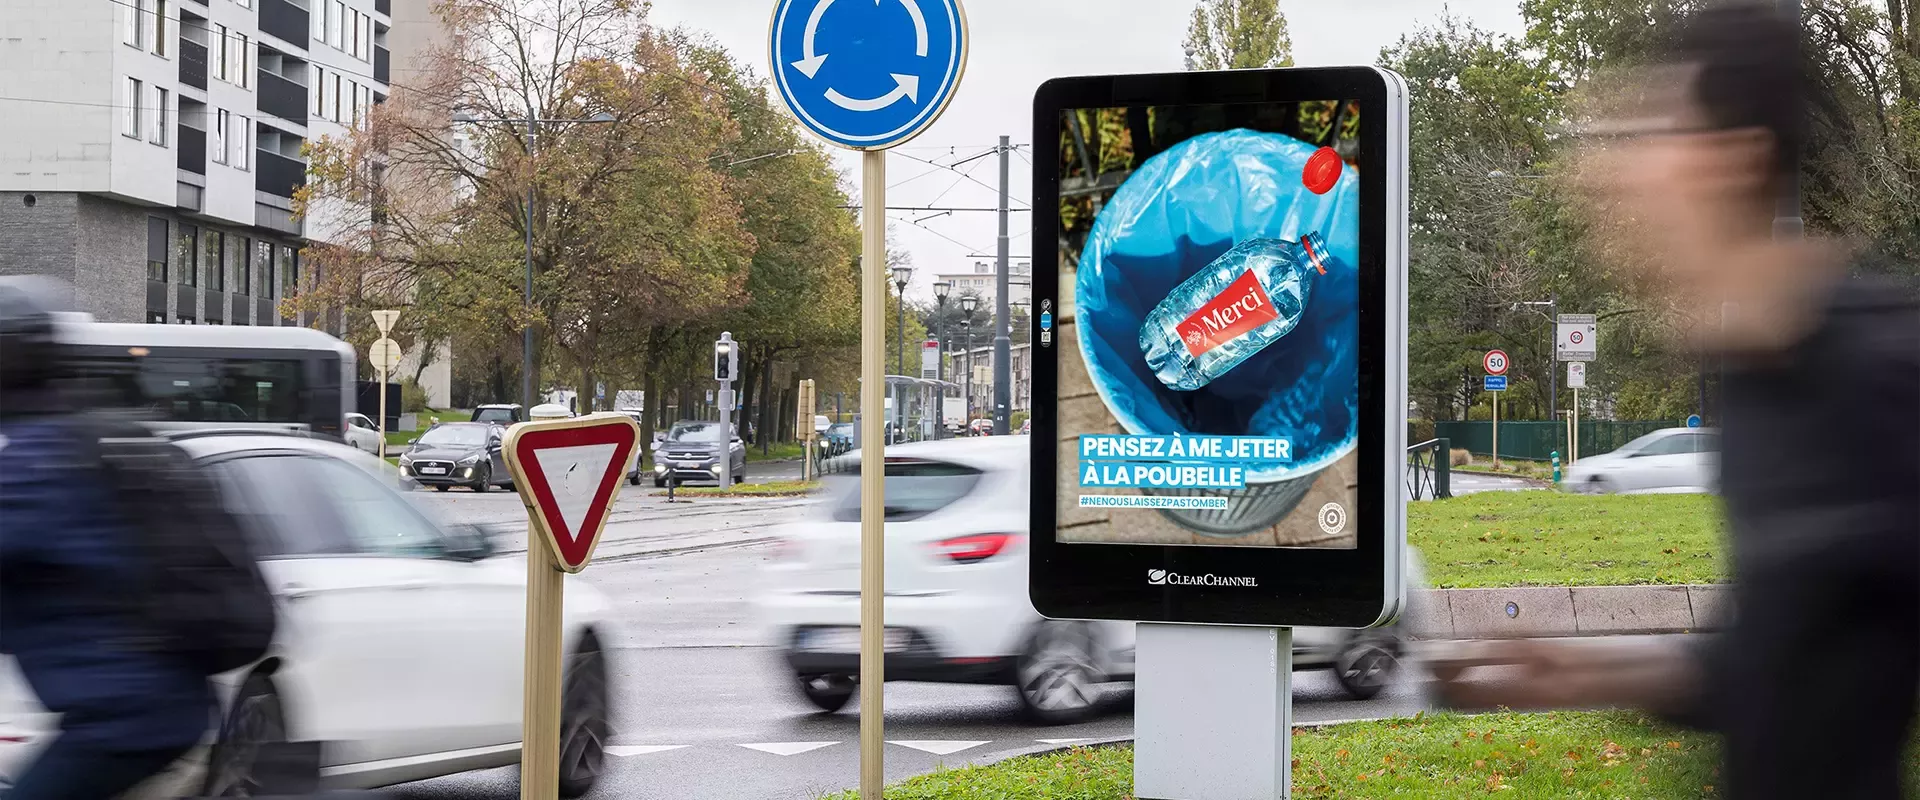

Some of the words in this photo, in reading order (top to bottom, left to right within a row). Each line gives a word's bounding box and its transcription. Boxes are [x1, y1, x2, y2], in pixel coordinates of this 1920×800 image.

[1201, 286, 1264, 336] Merci
[1490, 358, 1503, 368] 50
[1083, 437, 1165, 457] PENSEZ
[1168, 431, 1186, 457] À
[1189, 438, 1222, 458] ME
[1225, 438, 1290, 459] JETER
[1082, 460, 1100, 485] À
[1103, 466, 1131, 485] LA
[1134, 466, 1241, 487] POUBELLE
[1080, 497, 1226, 508] #NENOUSLAISSEZPASTOMBER
